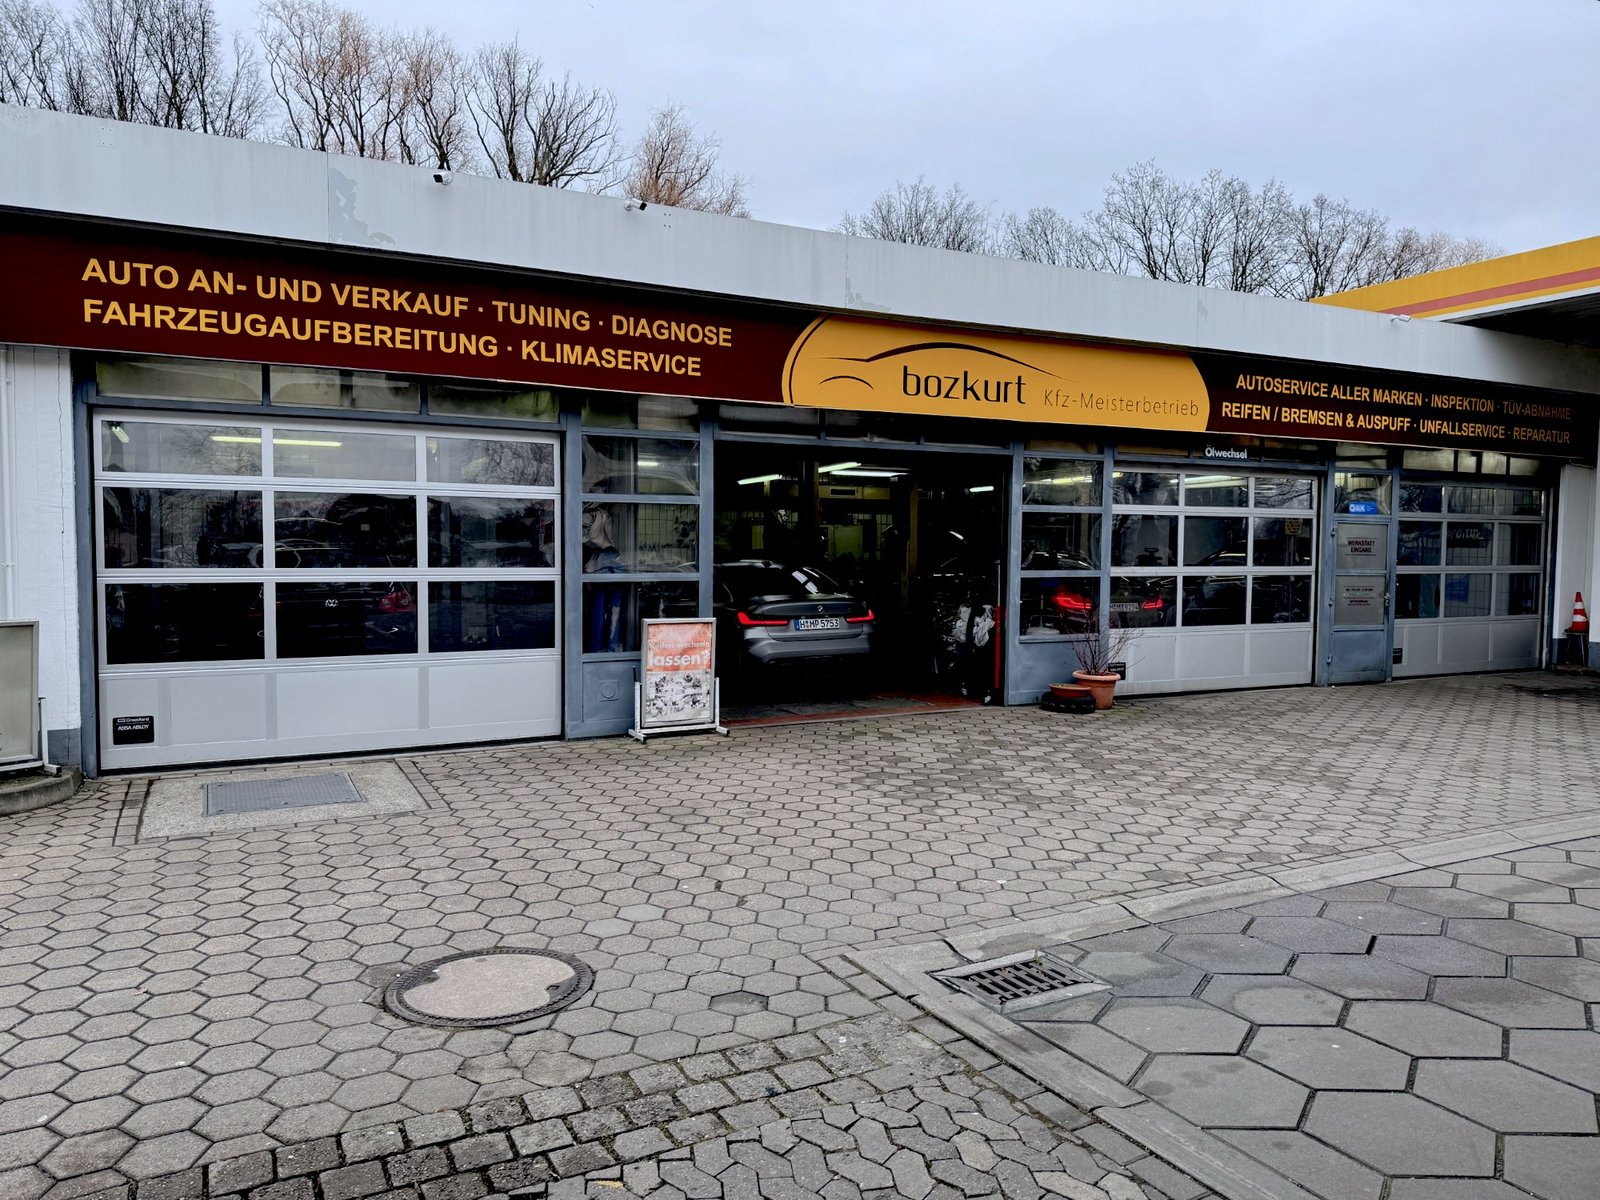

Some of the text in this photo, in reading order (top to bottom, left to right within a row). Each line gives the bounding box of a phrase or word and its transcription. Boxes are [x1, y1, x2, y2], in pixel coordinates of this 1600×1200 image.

[81, 257, 732, 347] AUTO AN- UND VERKAUF TUNING DIAGNOSE
[83, 298, 702, 376] FAHRZEUGAUFBEREITUNG KLIMASERVICE
[902, 365, 1026, 405] bozkurt
[1044, 388, 1199, 417] Kfz-Meisterbetrieb
[1236, 374, 1571, 420] AUTOSERVICE ALLER MARKEN INSPEKTION TÜV-ABNAHME
[1222, 402, 1571, 444] REIFEN / BREMSEN & AUSPUFF UNFALLSERVICE REPARATUR
[1205, 444, 1248, 459] Ölwechsel
[820, 618, 839, 628] 5753
[648, 649, 711, 667] lassen?
